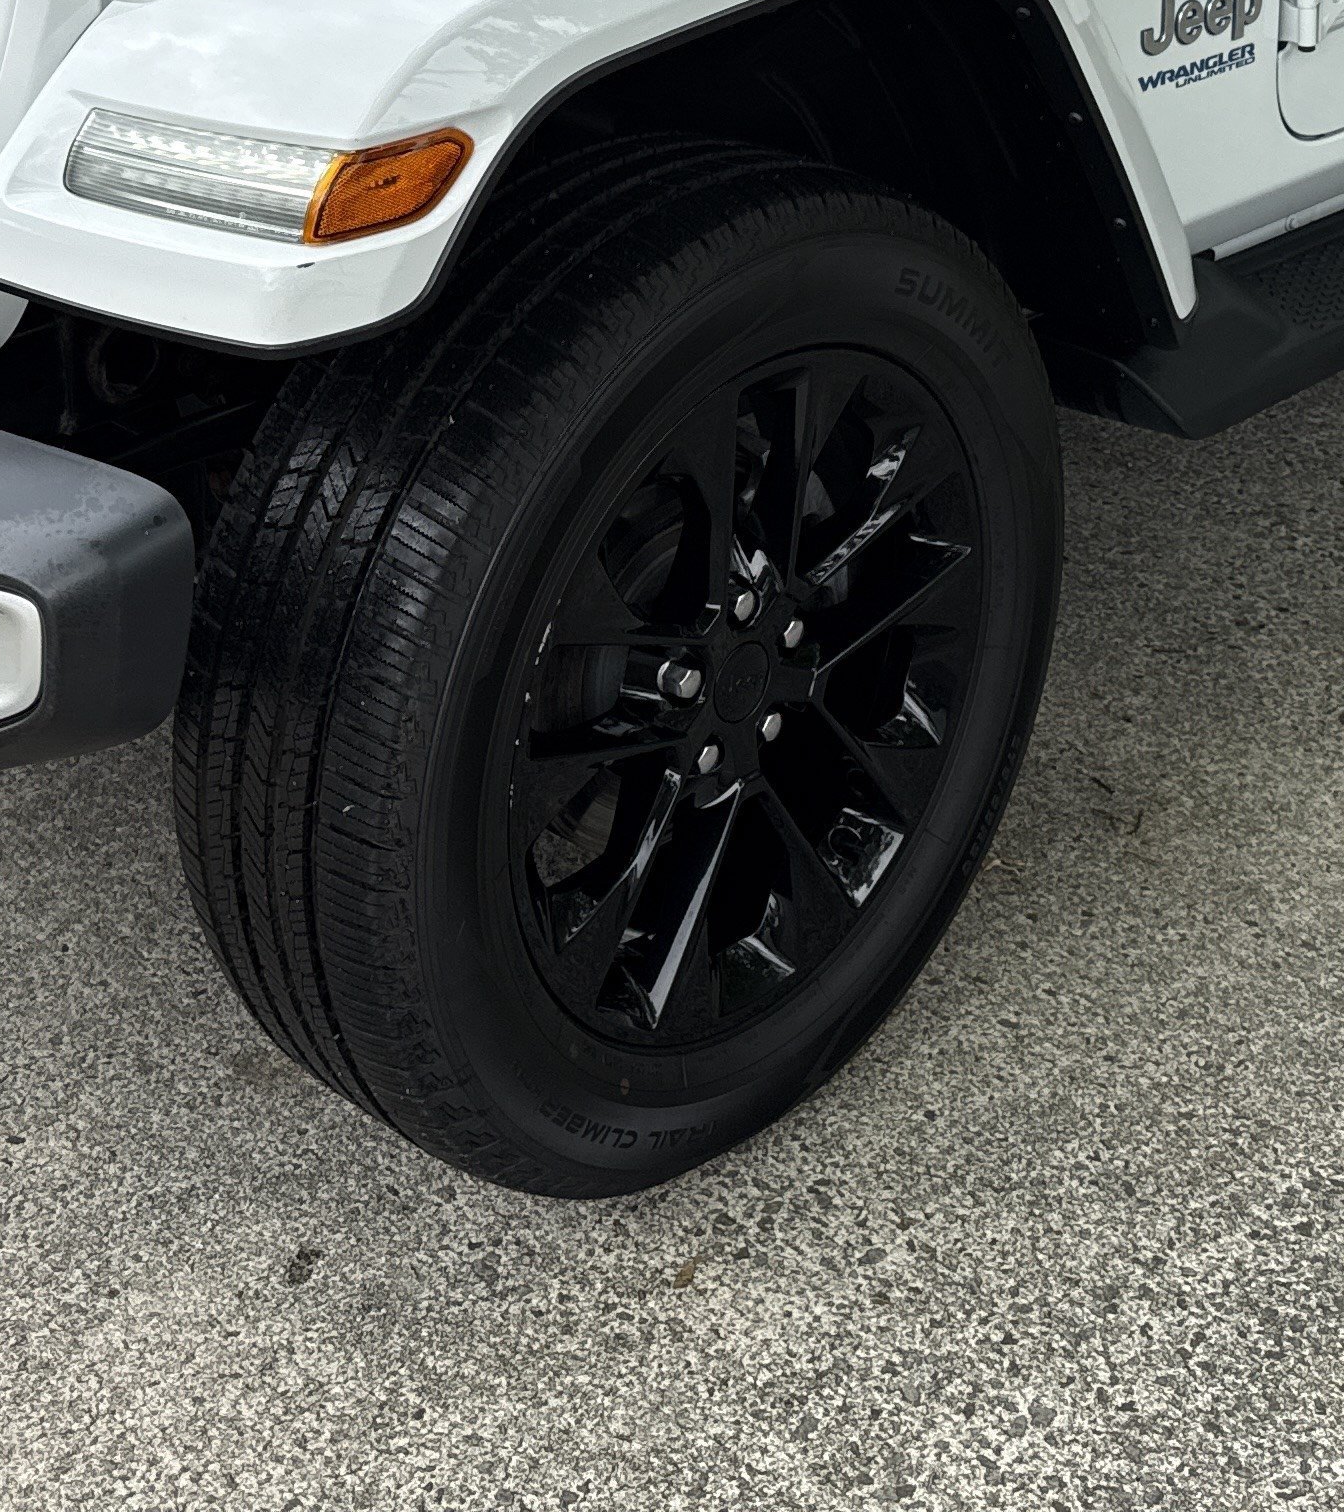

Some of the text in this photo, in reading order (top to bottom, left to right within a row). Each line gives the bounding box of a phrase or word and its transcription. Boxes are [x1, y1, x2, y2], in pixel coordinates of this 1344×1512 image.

[1137, 42, 1256, 92] WRANGLER
[1174, 57, 1256, 89] UNLIMITED
[894, 268, 1013, 367] SUMMIT
